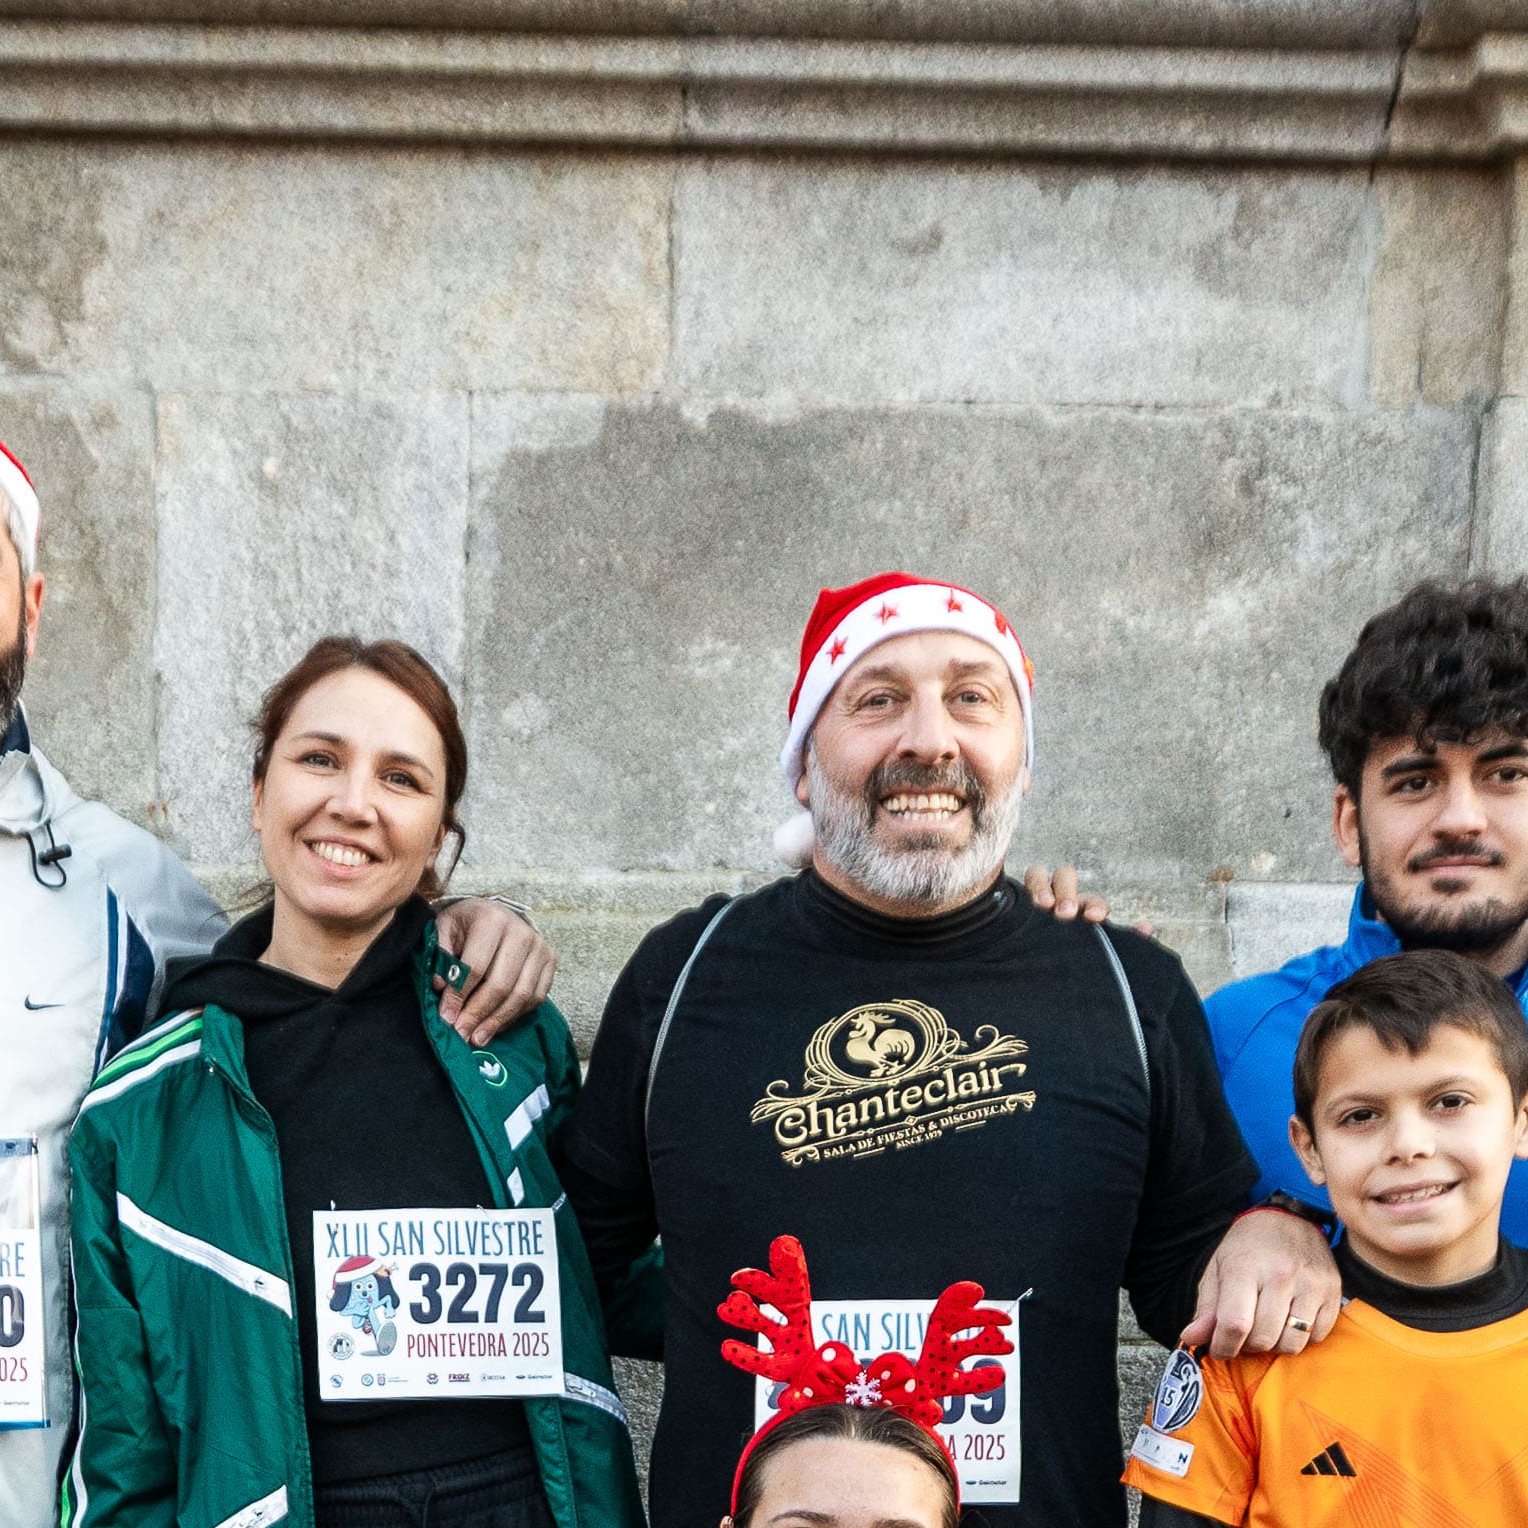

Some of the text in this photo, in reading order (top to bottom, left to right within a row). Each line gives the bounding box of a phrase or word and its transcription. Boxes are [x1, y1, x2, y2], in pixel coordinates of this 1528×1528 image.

[775, 1061, 1027, 1146] Chanteclair
[824, 1104, 1009, 1158] SALA DE FIESTAS & DISCOTECA
[895, 1135, 924, 1150] SINCE
[326, 1220, 544, 1258] XLII SAN SILVESTRE
[408, 1262, 546, 1324] 3272
[407, 1332, 550, 1358] PONTEVEDRA 2025
[822, 1313, 870, 1350] SAN
[964, 1434, 1005, 1460] 2025
